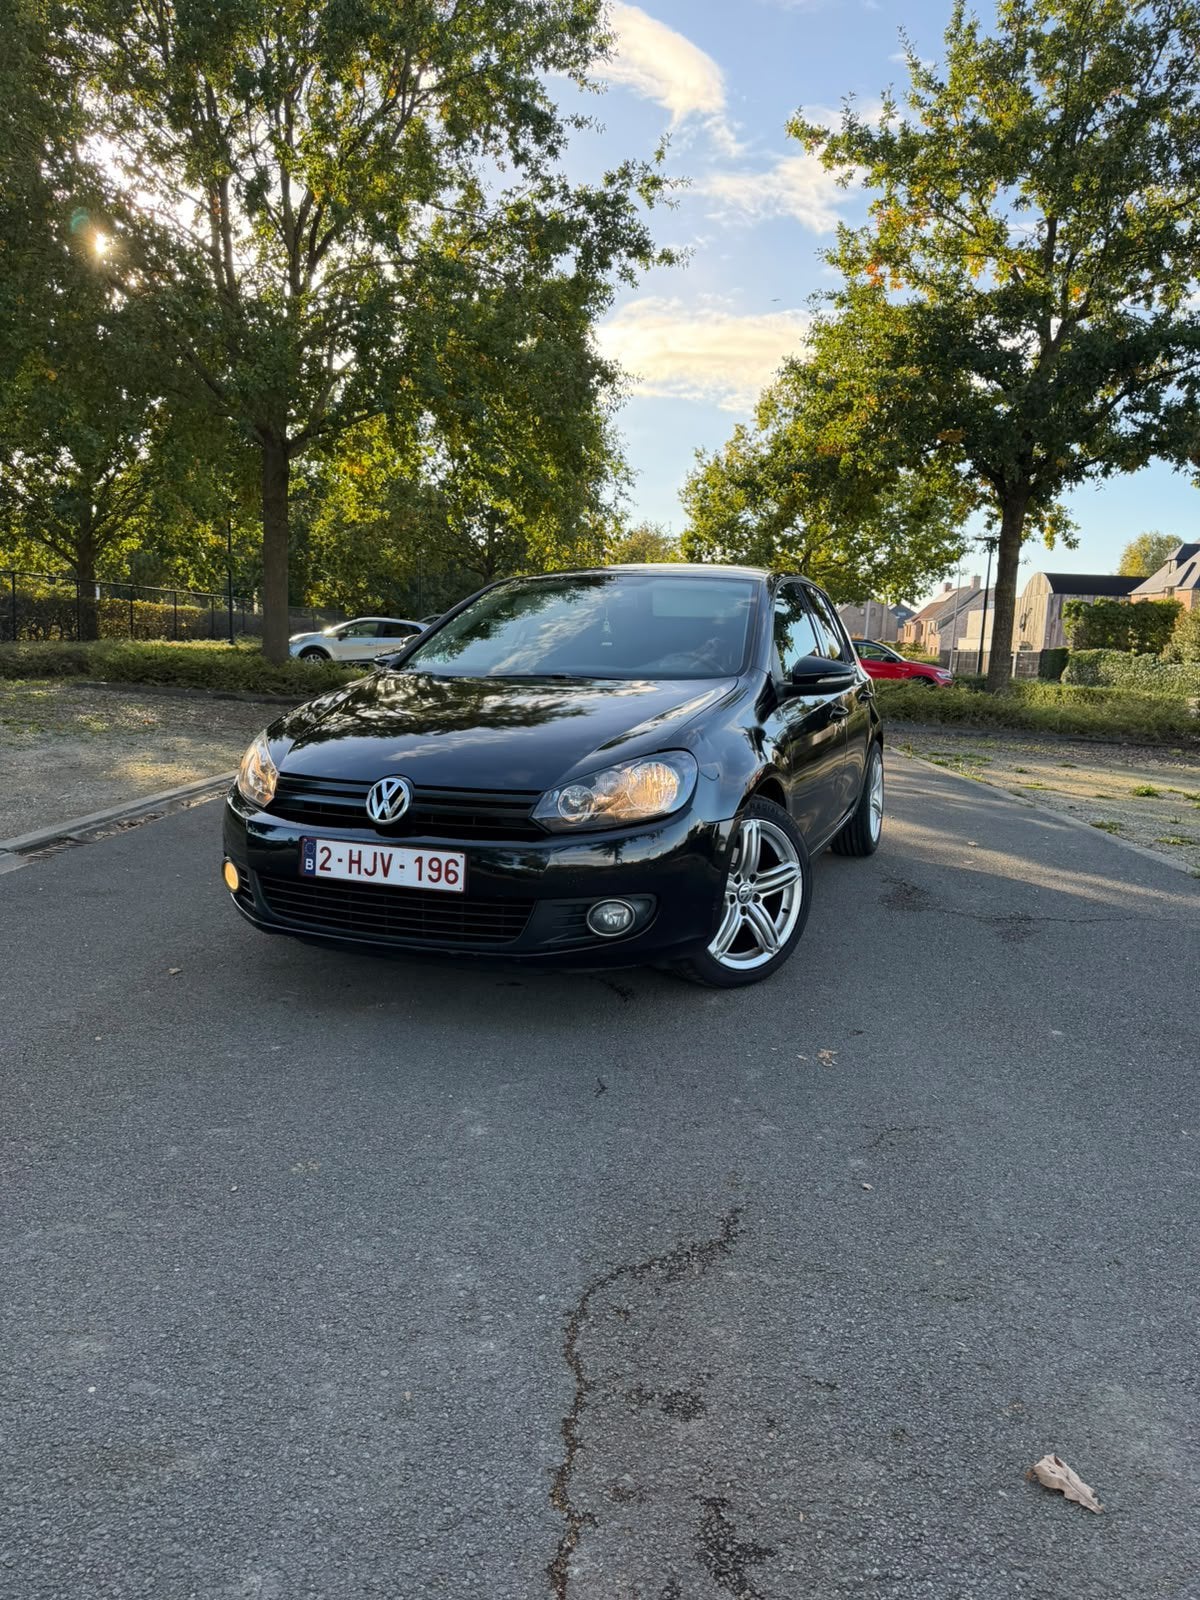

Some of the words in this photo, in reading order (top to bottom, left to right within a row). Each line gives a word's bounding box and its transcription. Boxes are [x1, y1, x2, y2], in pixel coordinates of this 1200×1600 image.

[367, 778, 409, 823] VW
[305, 858, 314, 870] B
[319, 846, 459, 885] 2-HJV-196
